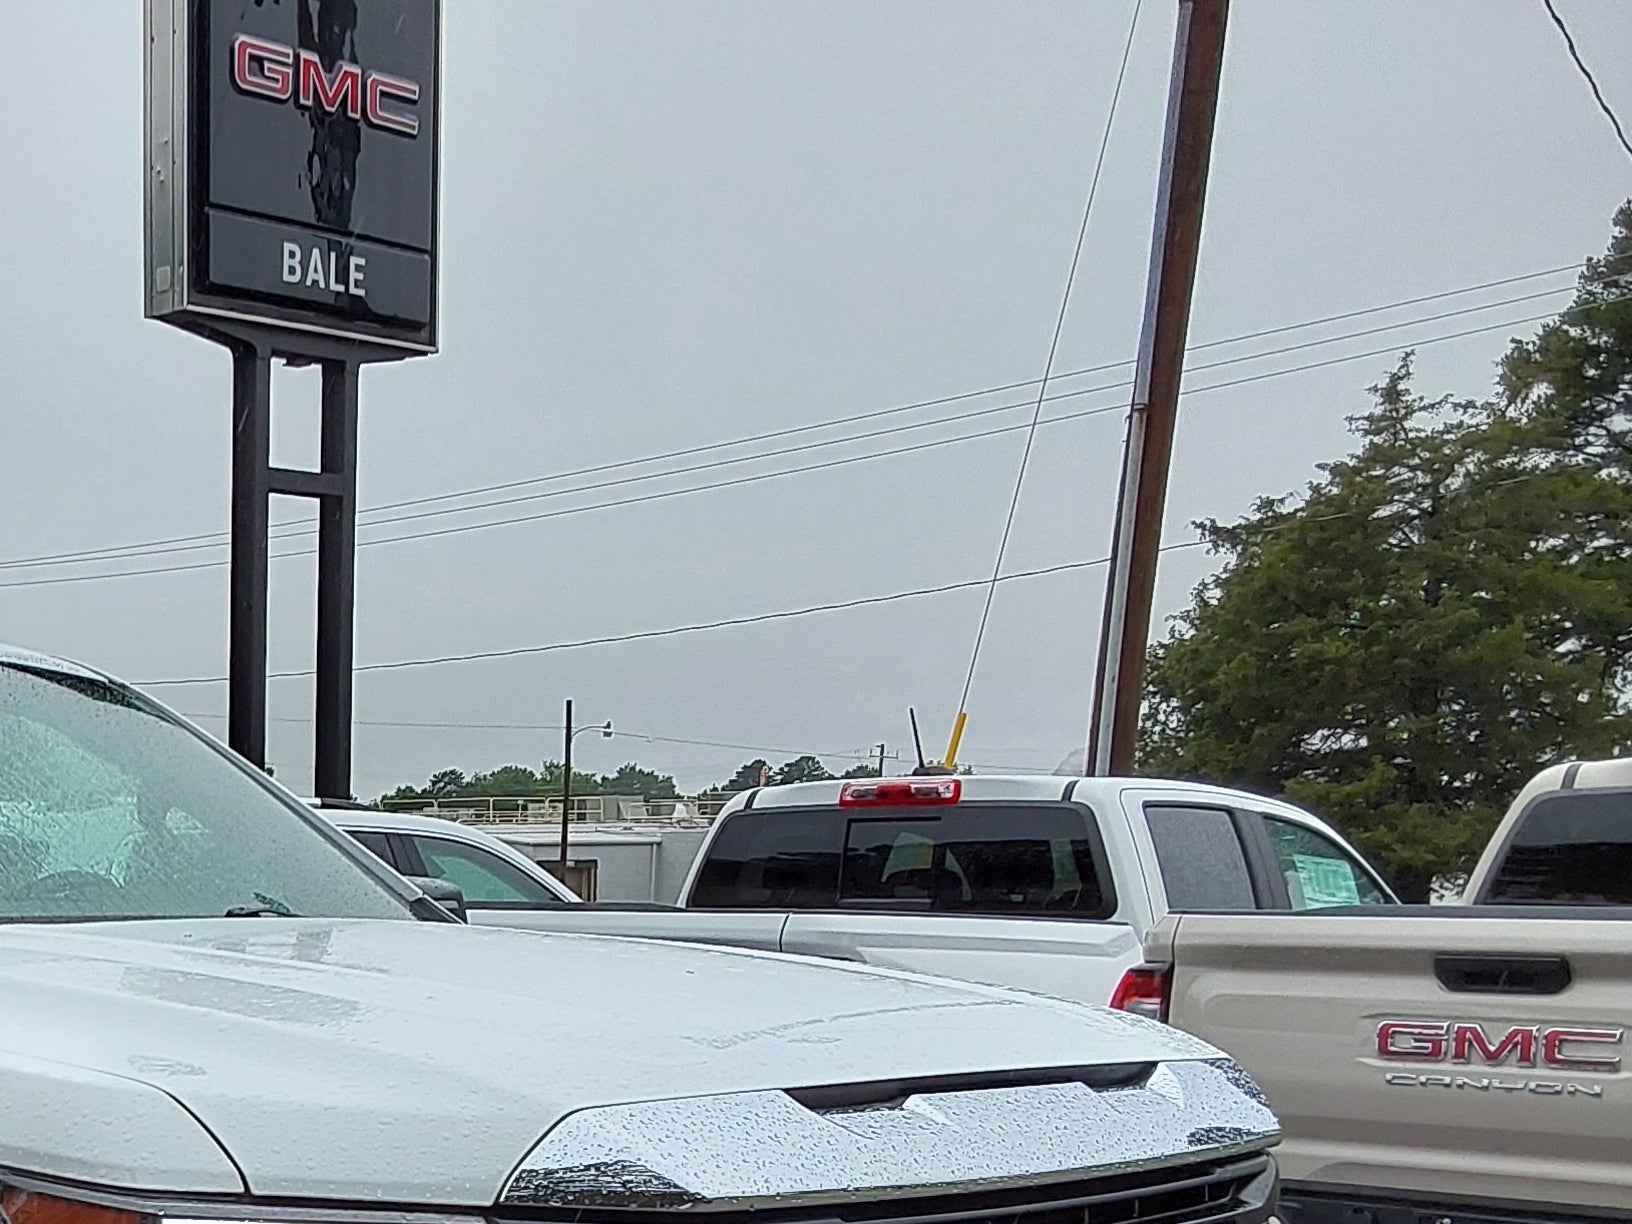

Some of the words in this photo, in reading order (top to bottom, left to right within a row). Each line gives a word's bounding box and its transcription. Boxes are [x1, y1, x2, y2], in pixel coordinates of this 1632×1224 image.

[234, 34, 419, 136] GMC
[282, 241, 367, 297] BALE
[1377, 1020, 1624, 1072] GMC
[1385, 1072, 1603, 1098] CANYON
